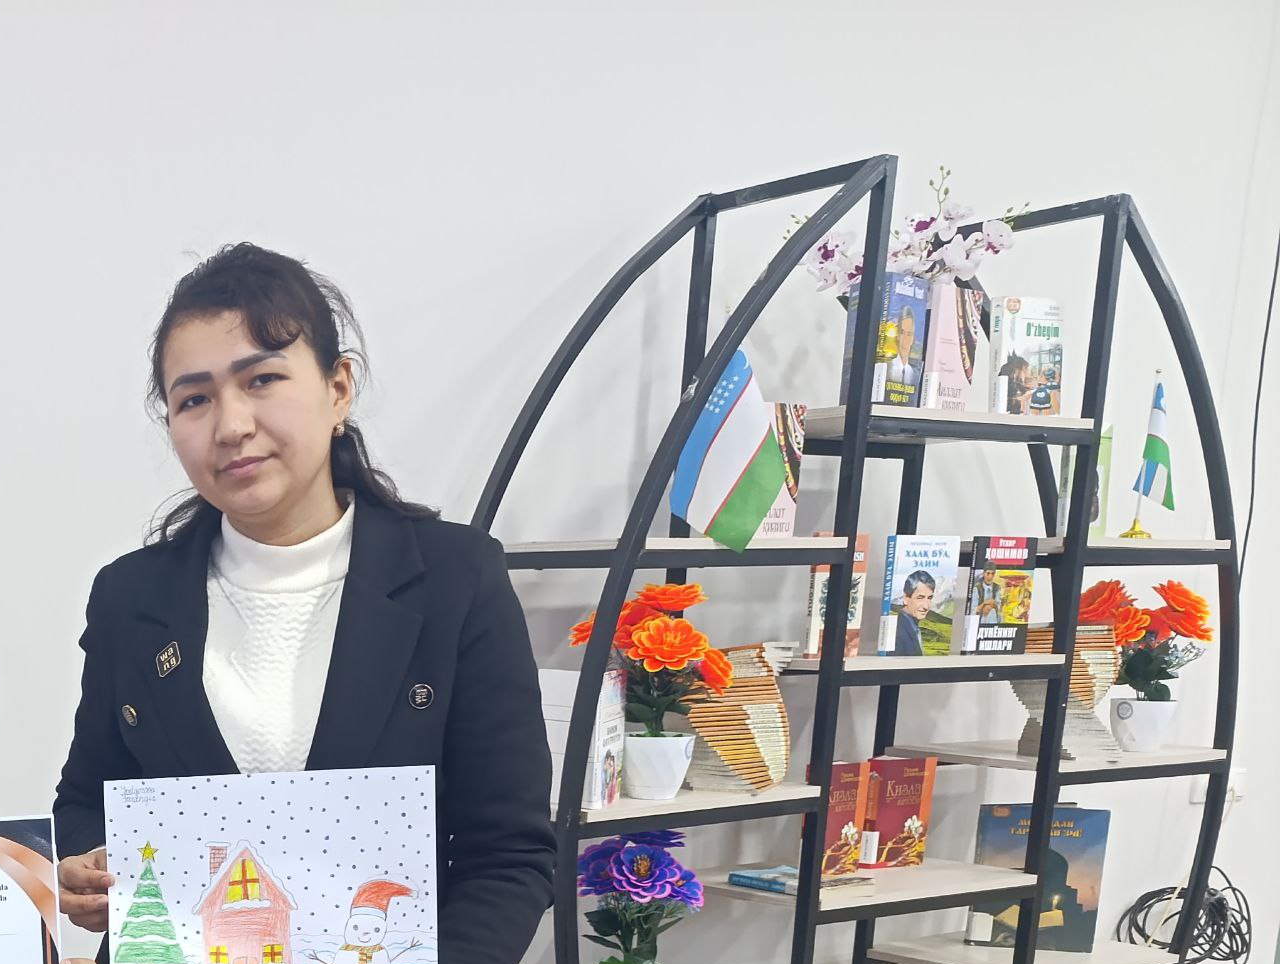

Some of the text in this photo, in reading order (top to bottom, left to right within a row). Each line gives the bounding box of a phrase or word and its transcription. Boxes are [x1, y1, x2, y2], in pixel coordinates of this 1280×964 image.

[985, 548, 1028, 560] ҚОШИМОВ
[912, 560, 939, 568] ЭЛИМ
[977, 626, 1017, 640] ДУНЁНИНГ
[979, 640, 1012, 651] ИШЛАРИ
